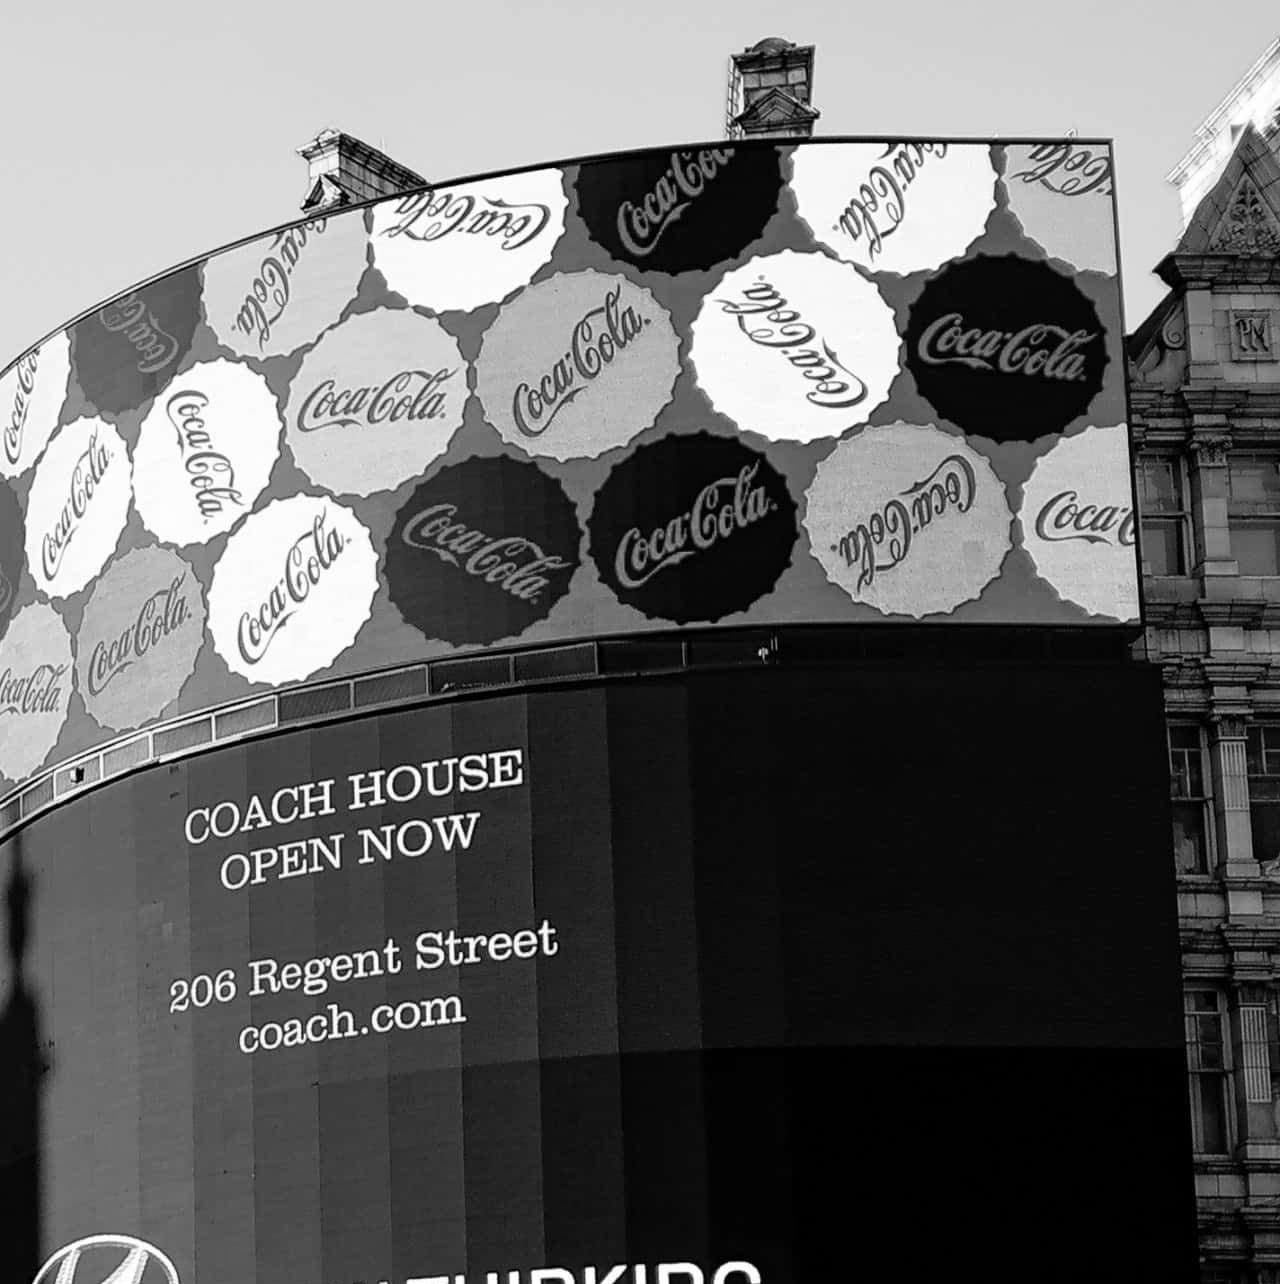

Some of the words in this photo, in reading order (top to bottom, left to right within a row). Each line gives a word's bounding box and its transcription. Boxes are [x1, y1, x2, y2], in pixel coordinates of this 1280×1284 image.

[297, 367, 460, 433] Coca-Cola
[513, 286, 651, 437] Coca-Cola
[716, 275, 867, 408] Coca-Cola
[918, 313, 1095, 382] Coca-Cola
[41, 424, 114, 582] Coca-Cola
[166, 389, 243, 524] Coca-Cola
[402, 503, 571, 604] Coca-Cola
[616, 461, 777, 588] Coca-Cola
[832, 454, 977, 590] Coca-Cola
[87, 574, 193, 696] Coca-Cola
[238, 507, 352, 665] Coca-Cola
[184, 779, 335, 844] COACH
[348, 749, 524, 812] HOUSE
[220, 836, 343, 890] OPEN
[358, 812, 482, 865] NOW
[170, 970, 236, 1013] 206
[248, 936, 402, 996] Regent
[415, 919, 559, 972] Street
[239, 994, 466, 1054] coach.com
